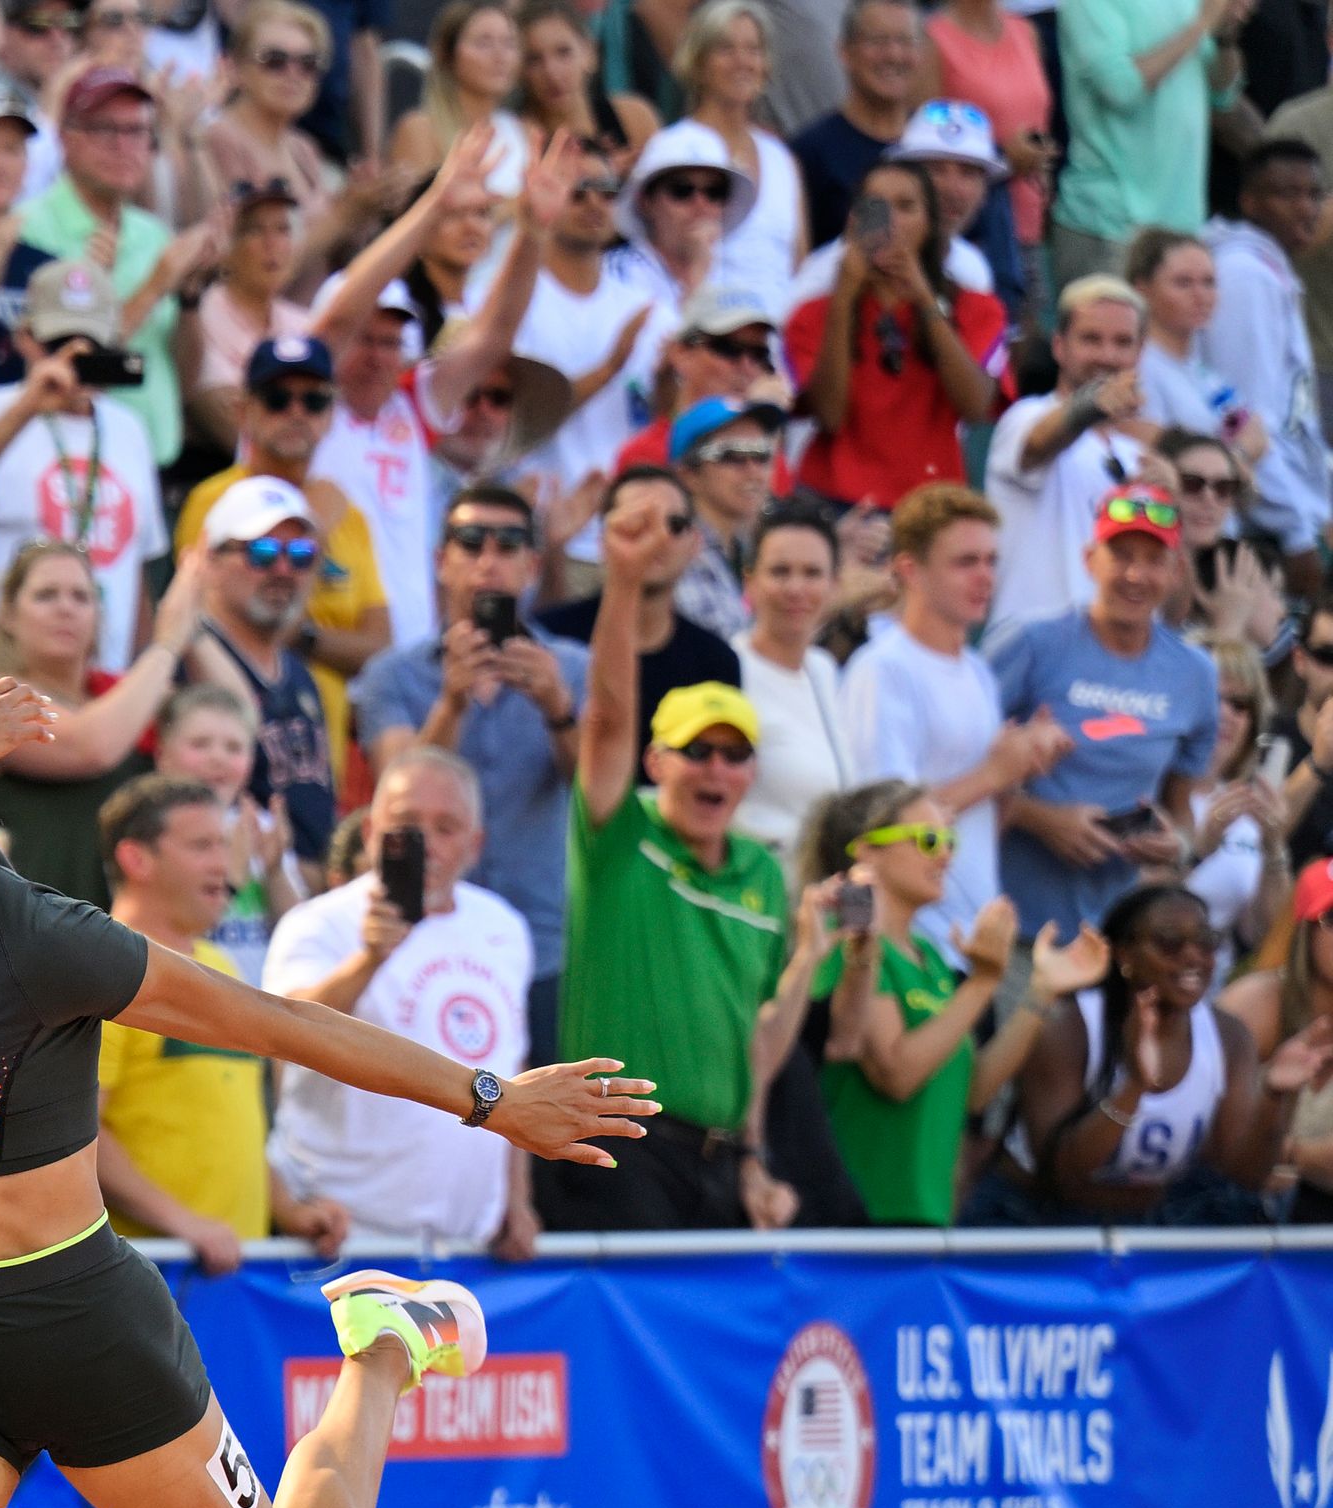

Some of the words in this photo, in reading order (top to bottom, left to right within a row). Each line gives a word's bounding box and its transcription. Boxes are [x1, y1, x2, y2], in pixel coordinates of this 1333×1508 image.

[895, 1324, 962, 1400] U.S.
[967, 1323, 1116, 1401] OLYMPIC
[422, 1371, 499, 1441] TEAM
[500, 1369, 558, 1439] USA
[895, 1411, 990, 1487] TEAM
[996, 1409, 1115, 1485] TRIALS
